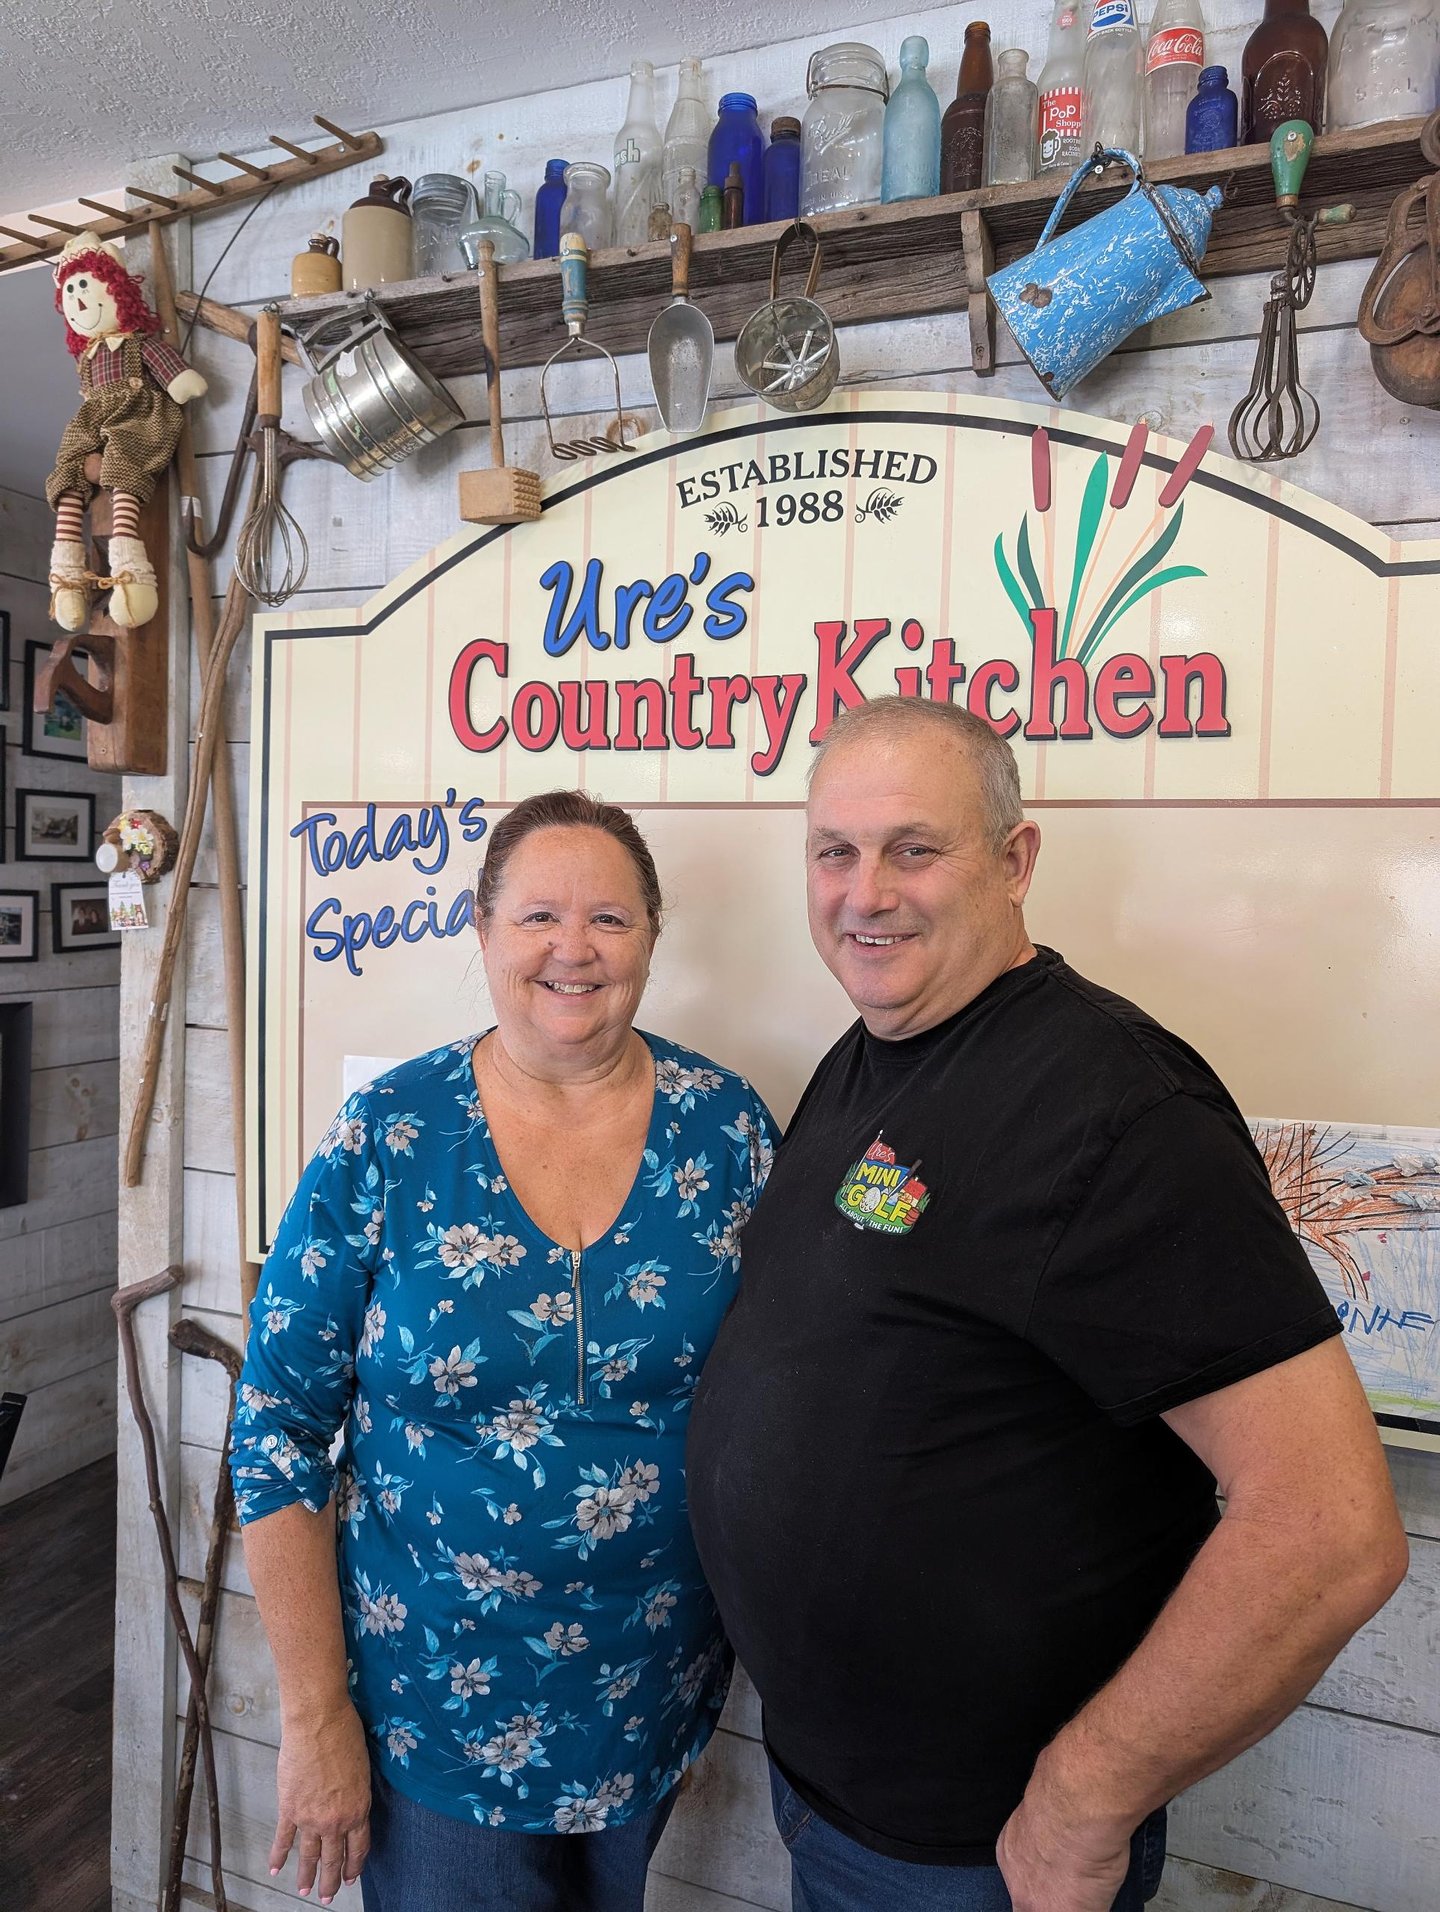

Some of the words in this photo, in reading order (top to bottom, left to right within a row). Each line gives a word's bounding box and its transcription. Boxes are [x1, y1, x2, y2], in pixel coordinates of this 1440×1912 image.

[1093, 3, 1129, 18] PEPSI
[1042, 100, 1056, 108] The
[1055, 119, 1081, 129] Shopp
[675, 448, 938, 509] ESTABLISHED
[756, 489, 845, 528] 1988
[539, 551, 755, 657] Ure's
[448, 637, 808, 777] Country
[808, 606, 1232, 746] Kitchen
[290, 787, 488, 877] Today's
[306, 868, 484, 976] Specia
[868, 1142, 896, 1163] Ure's
[855, 1162, 901, 1188] MINI
[839, 1203, 849, 1215] ALL
[847, 1210, 865, 1224] ABOUT
[868, 1220, 883, 1230] THE
[882, 1224, 904, 1234] FUN!
[847, 1184, 913, 1223] GOLF
